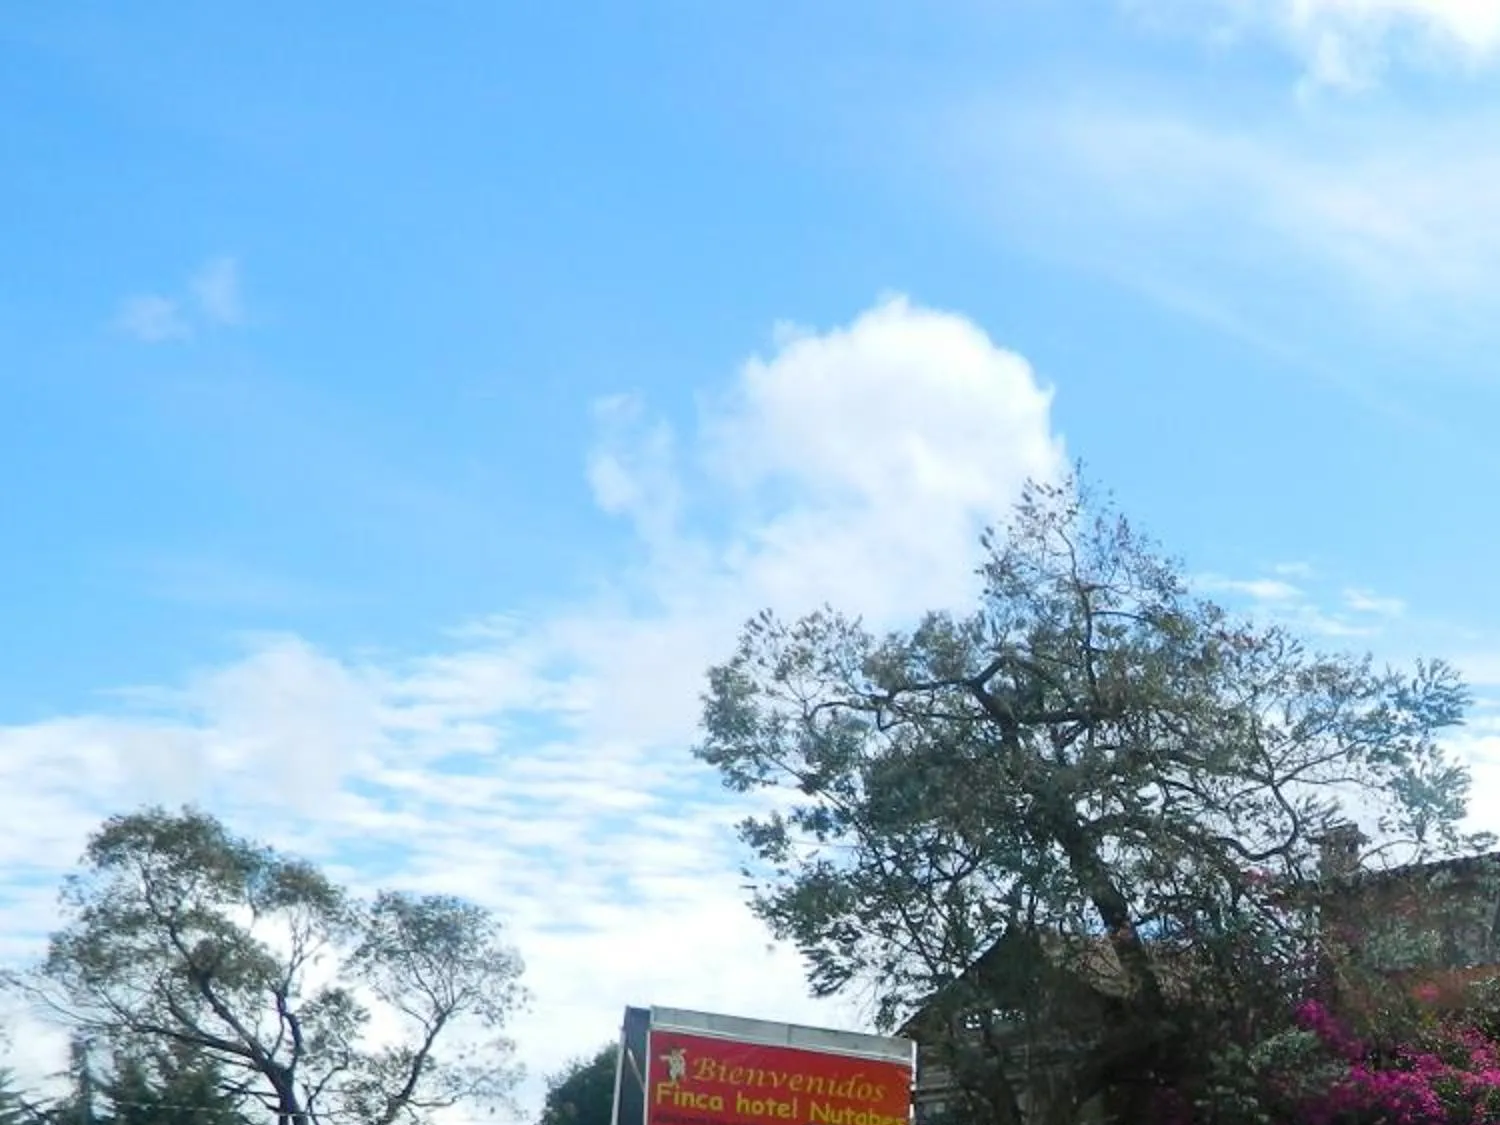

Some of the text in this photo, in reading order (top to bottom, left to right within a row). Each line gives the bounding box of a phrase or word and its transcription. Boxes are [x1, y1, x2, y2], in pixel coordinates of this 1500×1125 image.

[694, 1056, 887, 1101] Bienvenidos
[656, 1082, 724, 1112] Finca
[736, 1092, 798, 1119] hotel
